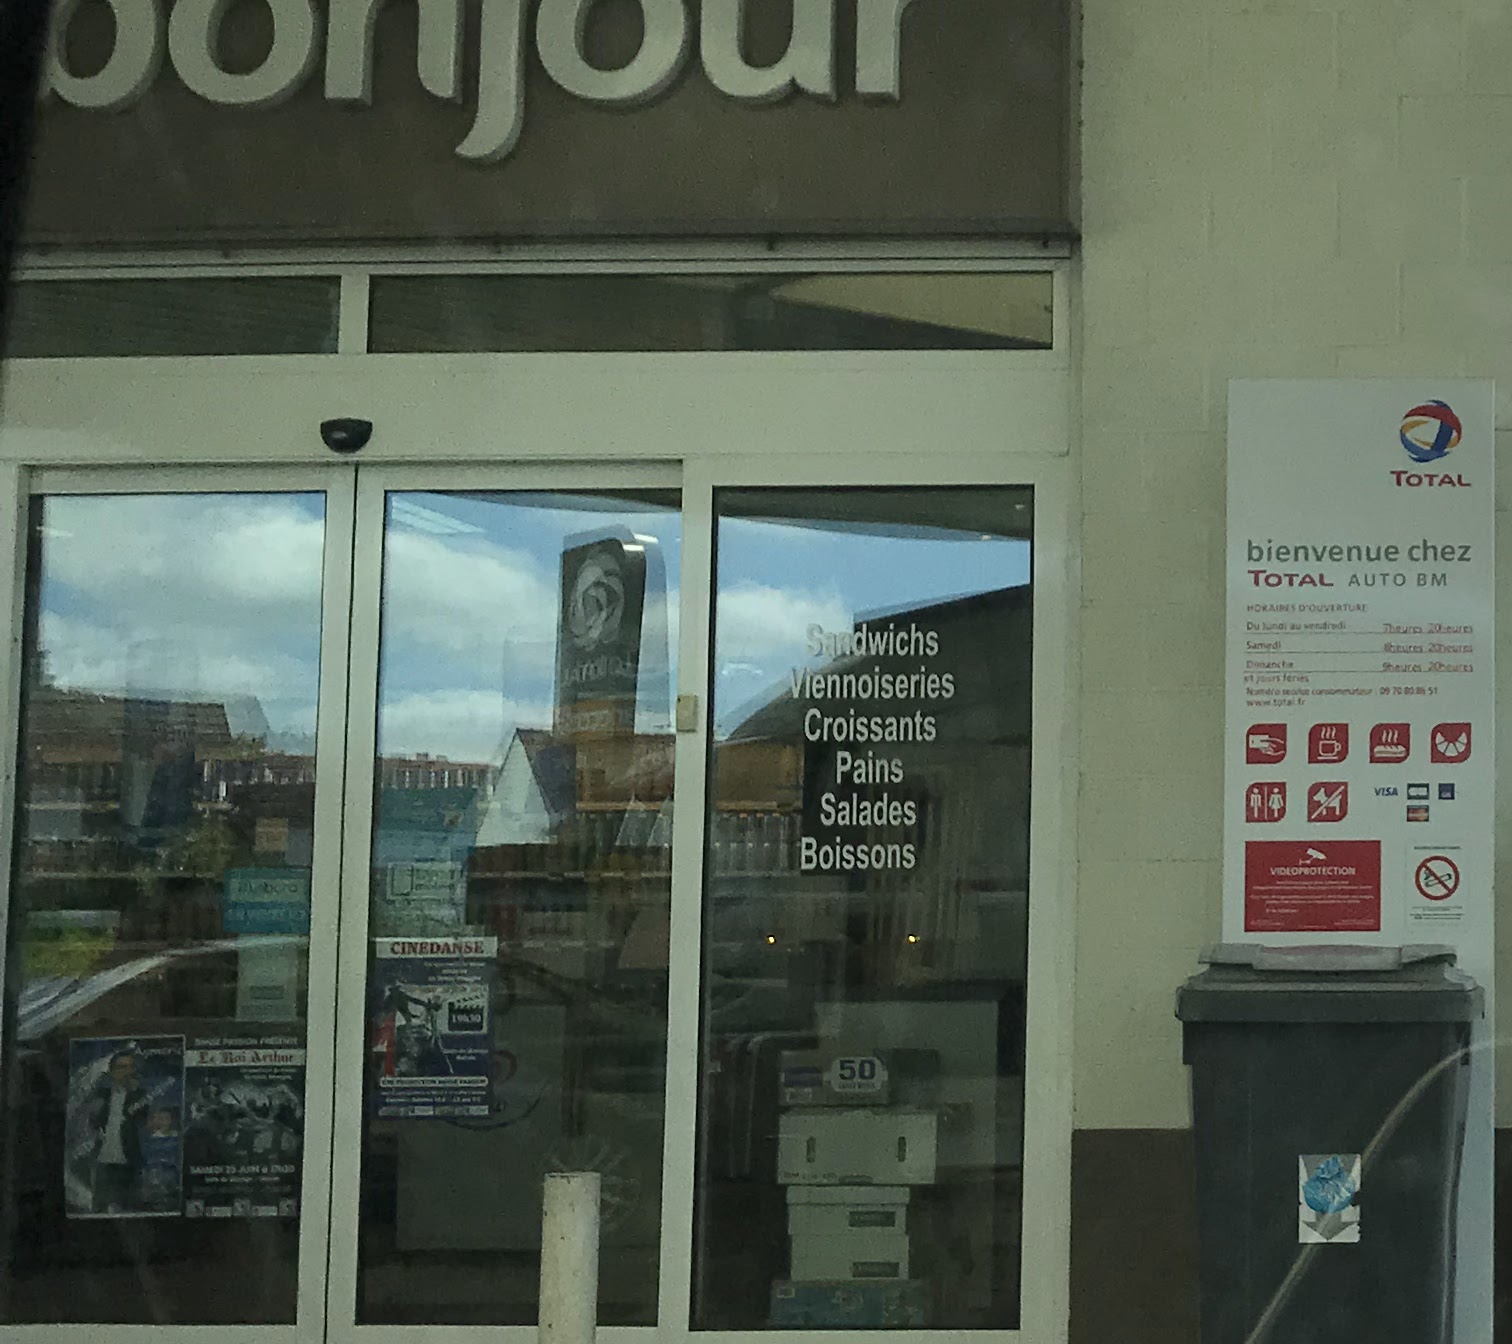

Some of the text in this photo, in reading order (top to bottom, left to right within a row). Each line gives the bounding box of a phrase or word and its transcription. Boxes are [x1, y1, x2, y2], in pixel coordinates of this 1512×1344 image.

[1389, 470, 1472, 487] TOTAL
[1247, 539, 1472, 563] bienvenue chez
[1247, 569, 1448, 588] TOTAL AUTO BM
[1246, 621, 1260, 631] Du
[1289, 622, 1302, 631] au
[1303, 620, 1347, 631] vendredi
[805, 622, 940, 657] Sandwichs
[1246, 640, 1282, 650] Samedi
[790, 664, 956, 700] Viennoiseries
[803, 707, 937, 743] Croissants
[835, 750, 905, 785] Pains
[1373, 786, 1399, 798] VISA
[819, 791, 918, 827] Salades
[800, 835, 917, 871] Boissons
[838, 1058, 877, 1081] 50
